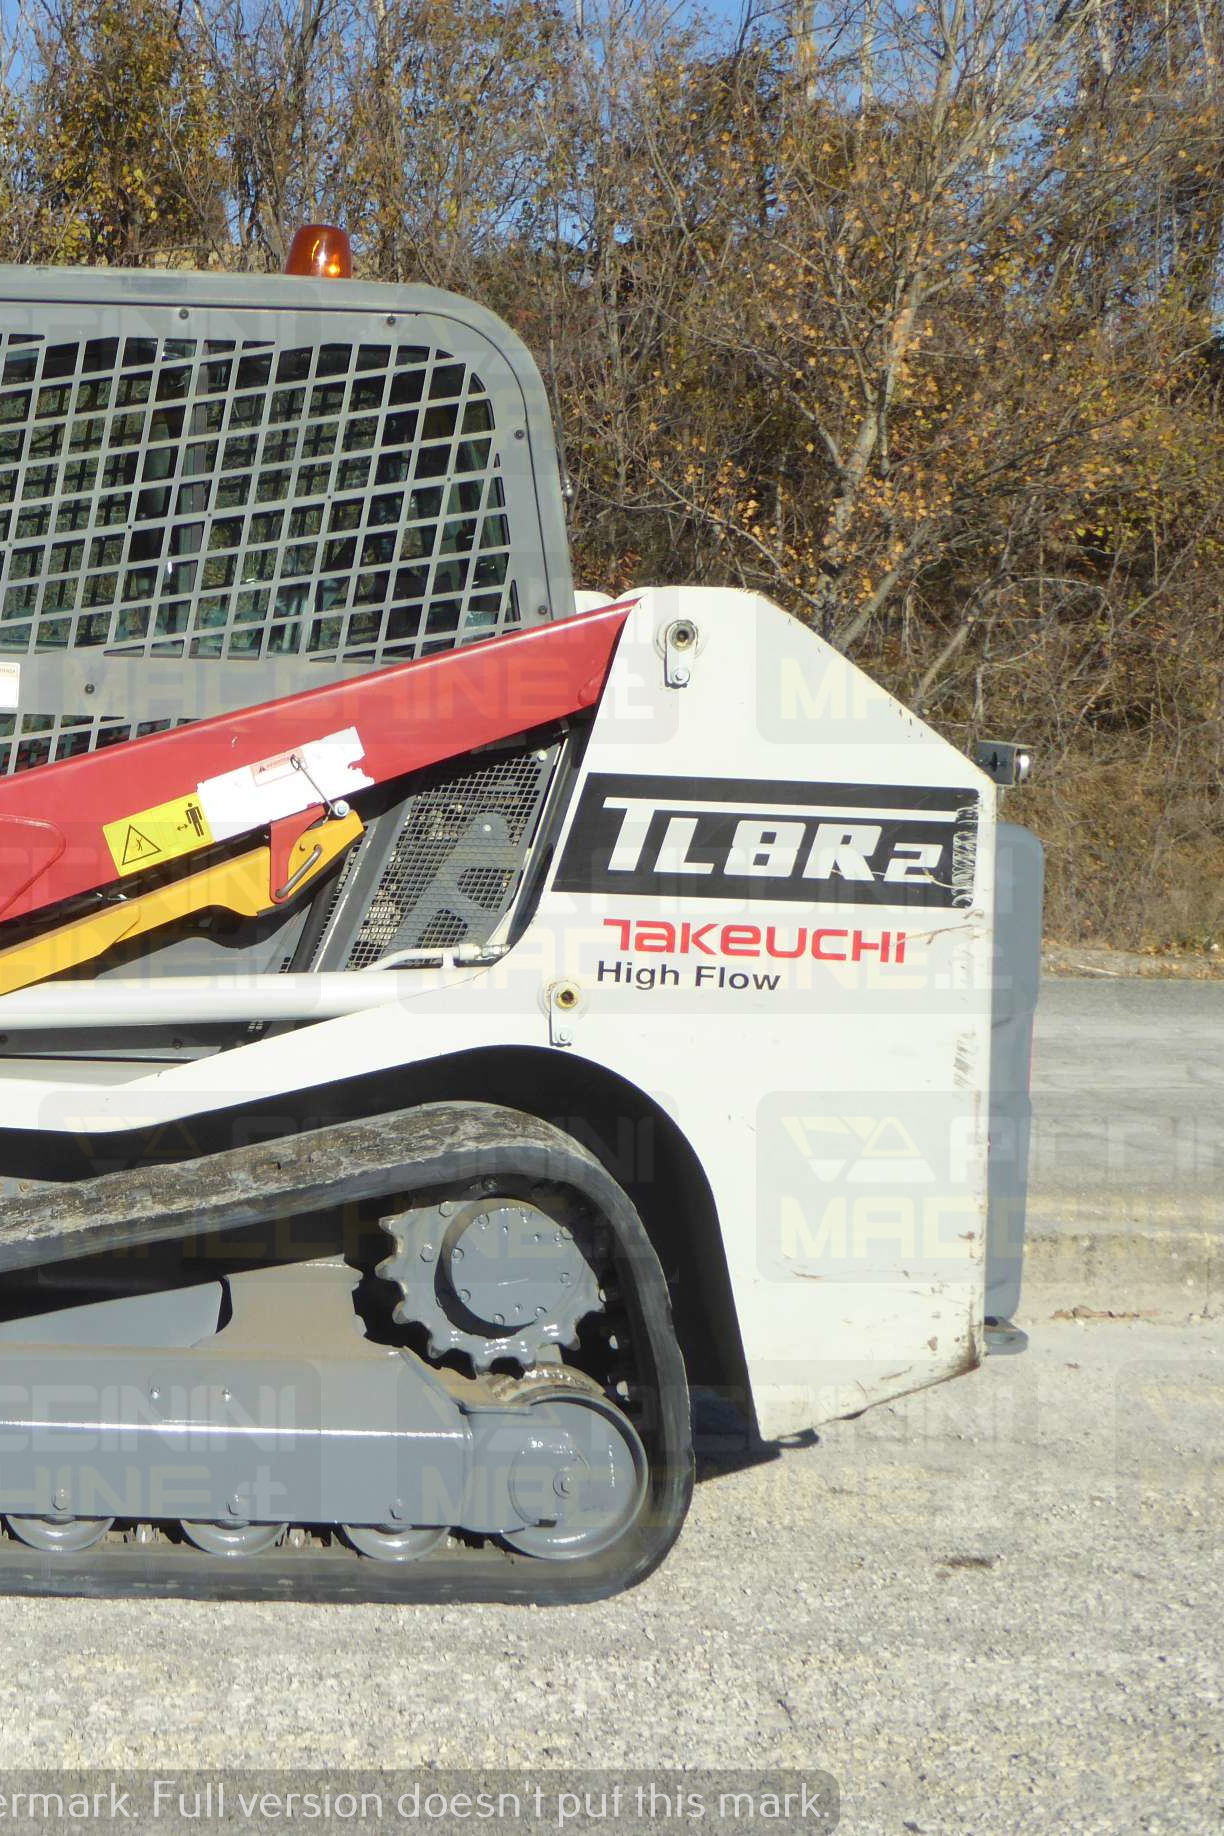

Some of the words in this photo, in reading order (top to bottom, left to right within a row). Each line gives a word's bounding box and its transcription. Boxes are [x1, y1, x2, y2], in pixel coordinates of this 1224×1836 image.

[603, 797, 958, 883] TL8R2
[597, 961, 679, 989] High
[695, 966, 781, 990] Flow
